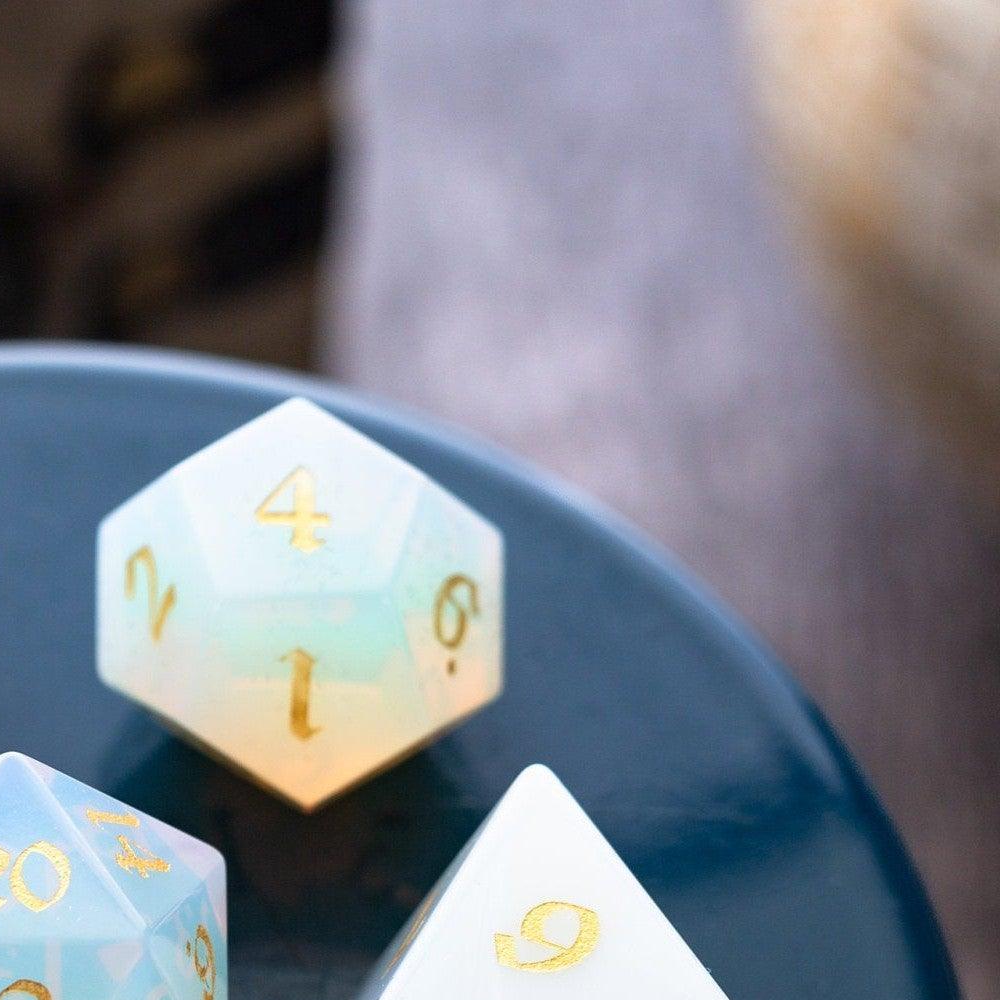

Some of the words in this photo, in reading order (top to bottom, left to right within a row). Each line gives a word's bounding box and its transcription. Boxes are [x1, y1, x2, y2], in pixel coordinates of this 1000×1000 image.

[255, 465, 331, 553] 4
[124, 544, 177, 642] 2
[279, 647, 323, 742] 1
